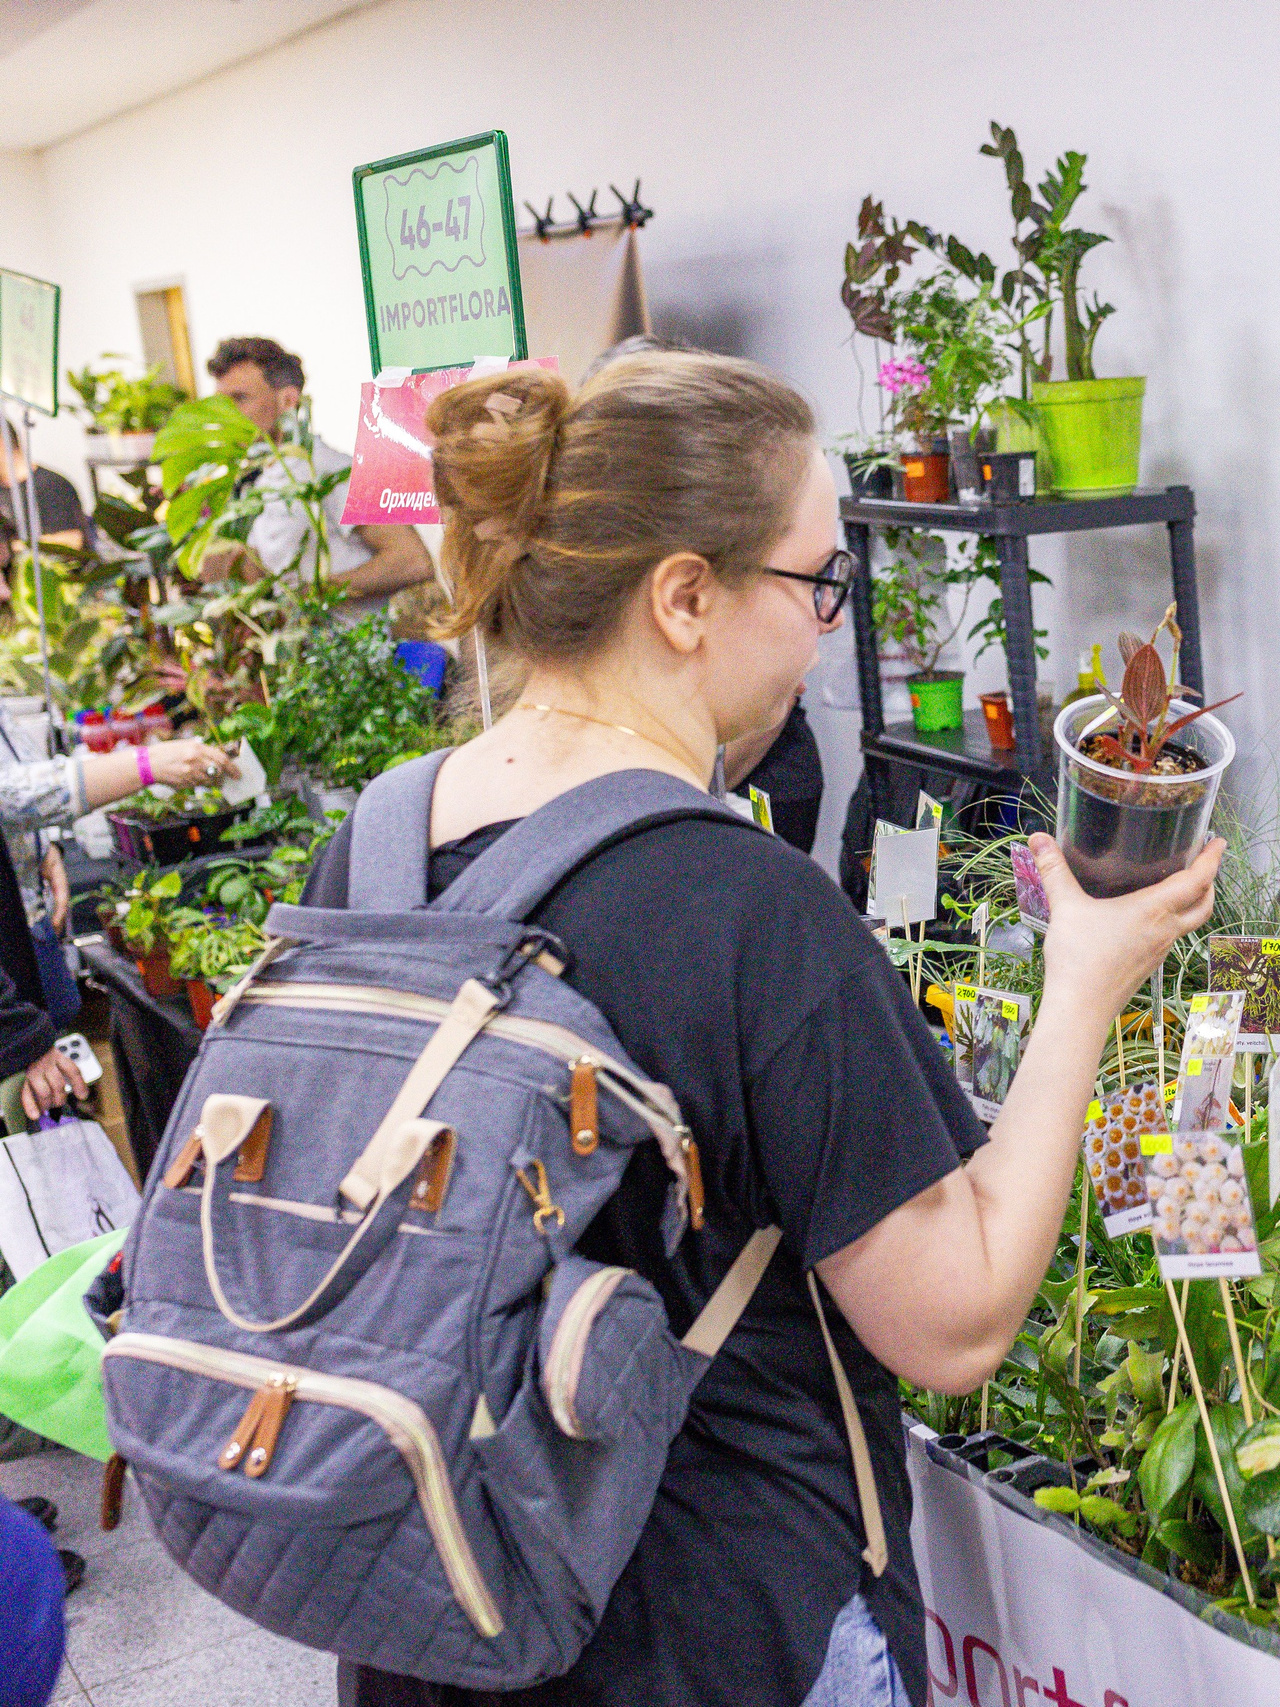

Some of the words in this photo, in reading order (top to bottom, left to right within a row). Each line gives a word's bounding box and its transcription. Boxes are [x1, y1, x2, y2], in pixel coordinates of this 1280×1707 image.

[400, 194, 471, 251] 46-47
[379, 285, 511, 333] IMPORTFLORA
[957, 987, 977, 999] 2700
